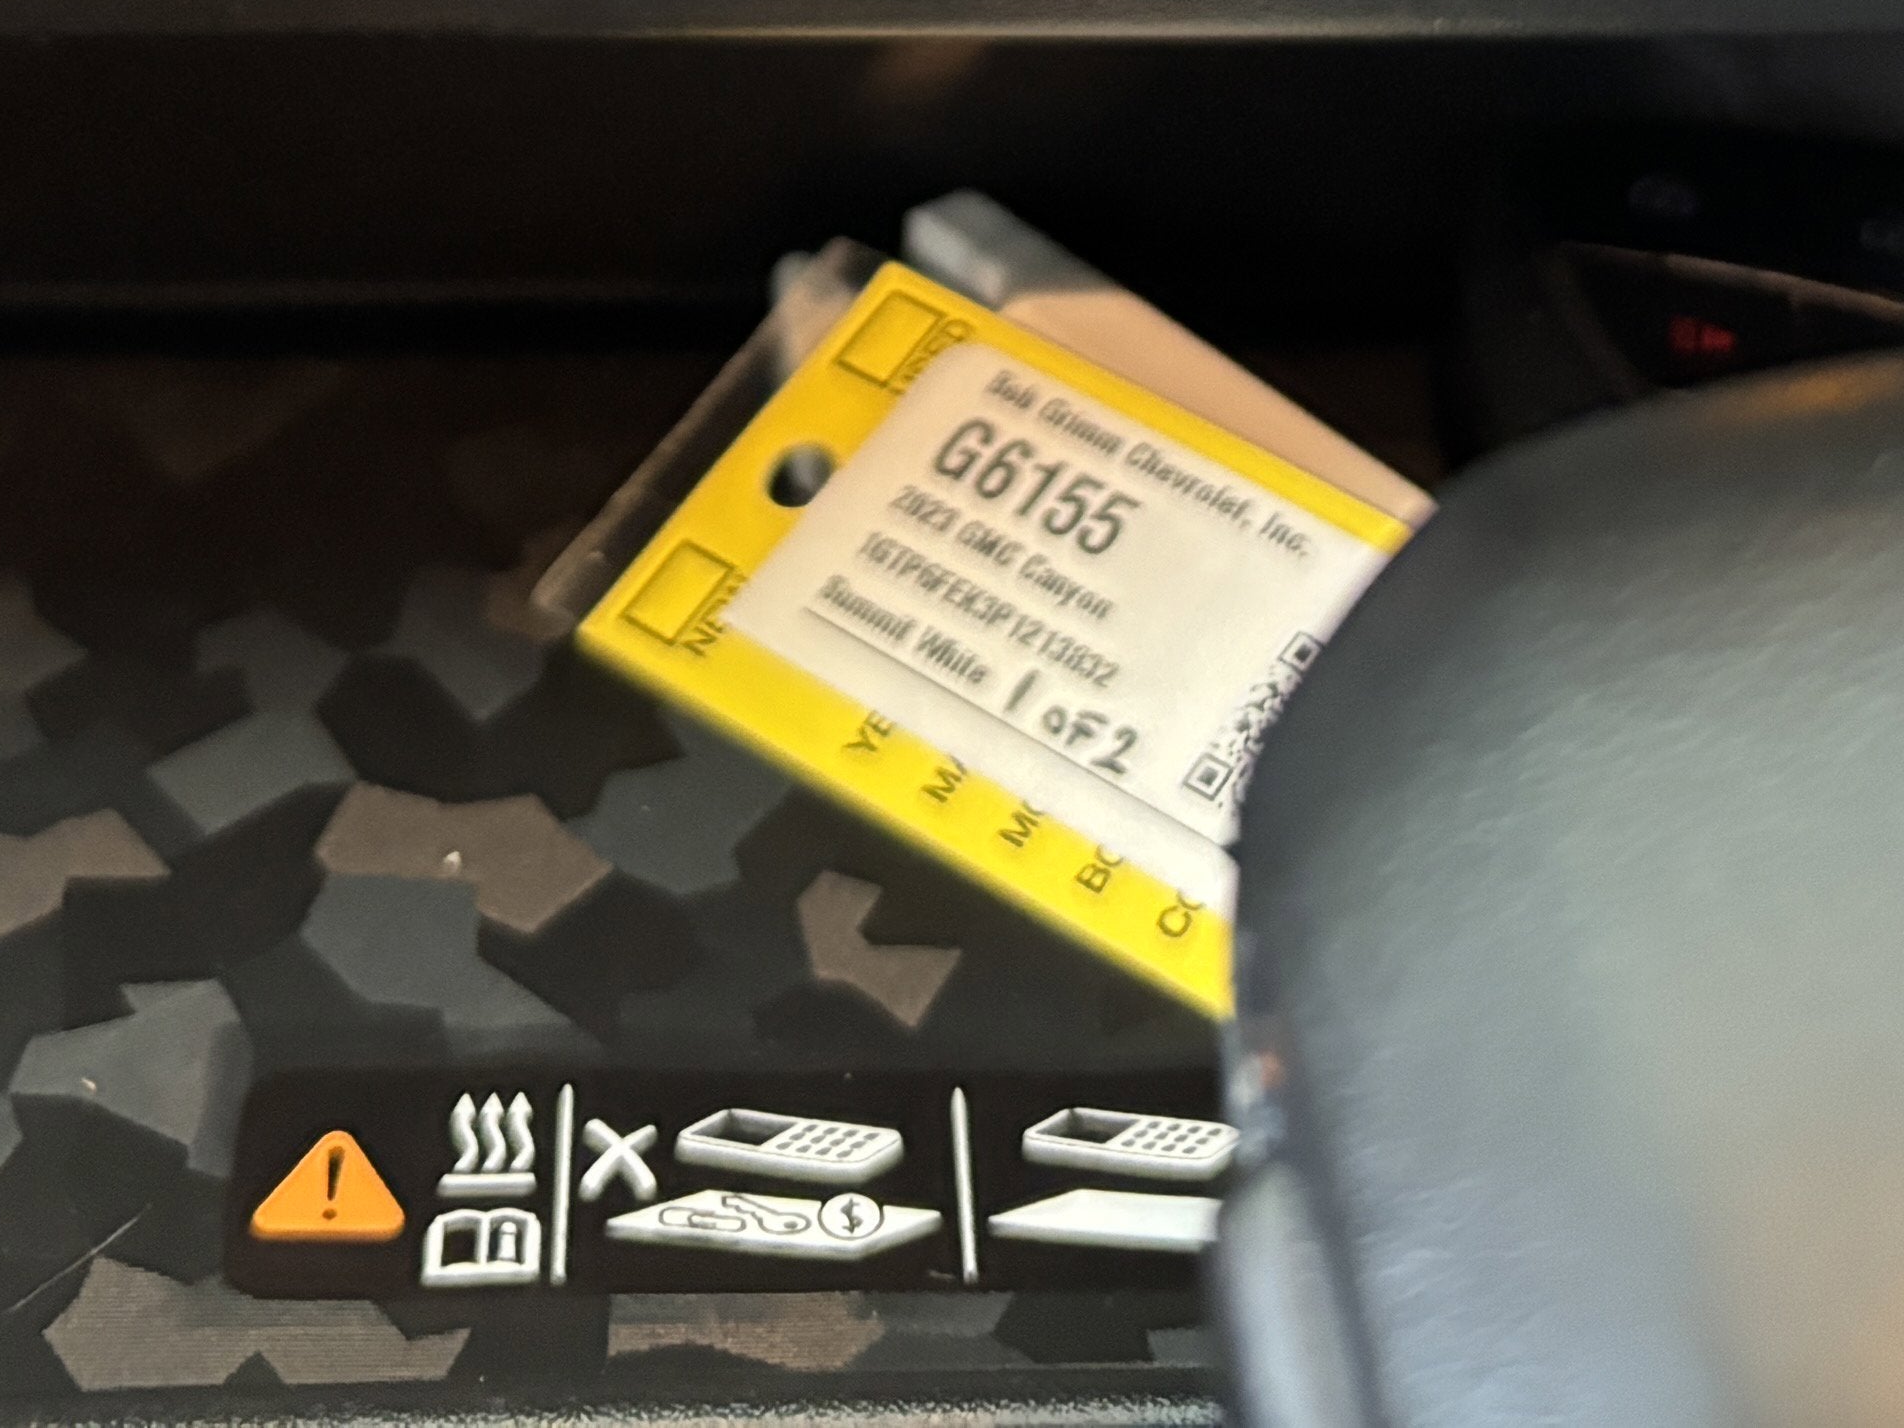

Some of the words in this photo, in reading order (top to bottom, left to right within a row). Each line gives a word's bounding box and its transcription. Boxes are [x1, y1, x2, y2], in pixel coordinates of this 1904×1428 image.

[932, 417, 1144, 557] G6155
[889, 484, 961, 533] 2023
[955, 519, 1025, 568] GMC
[1018, 552, 1115, 621] Canyon
[1258, 510, 1312, 559] Inc.
[912, 624, 993, 686] White
[1089, 724, 1140, 776] 2
